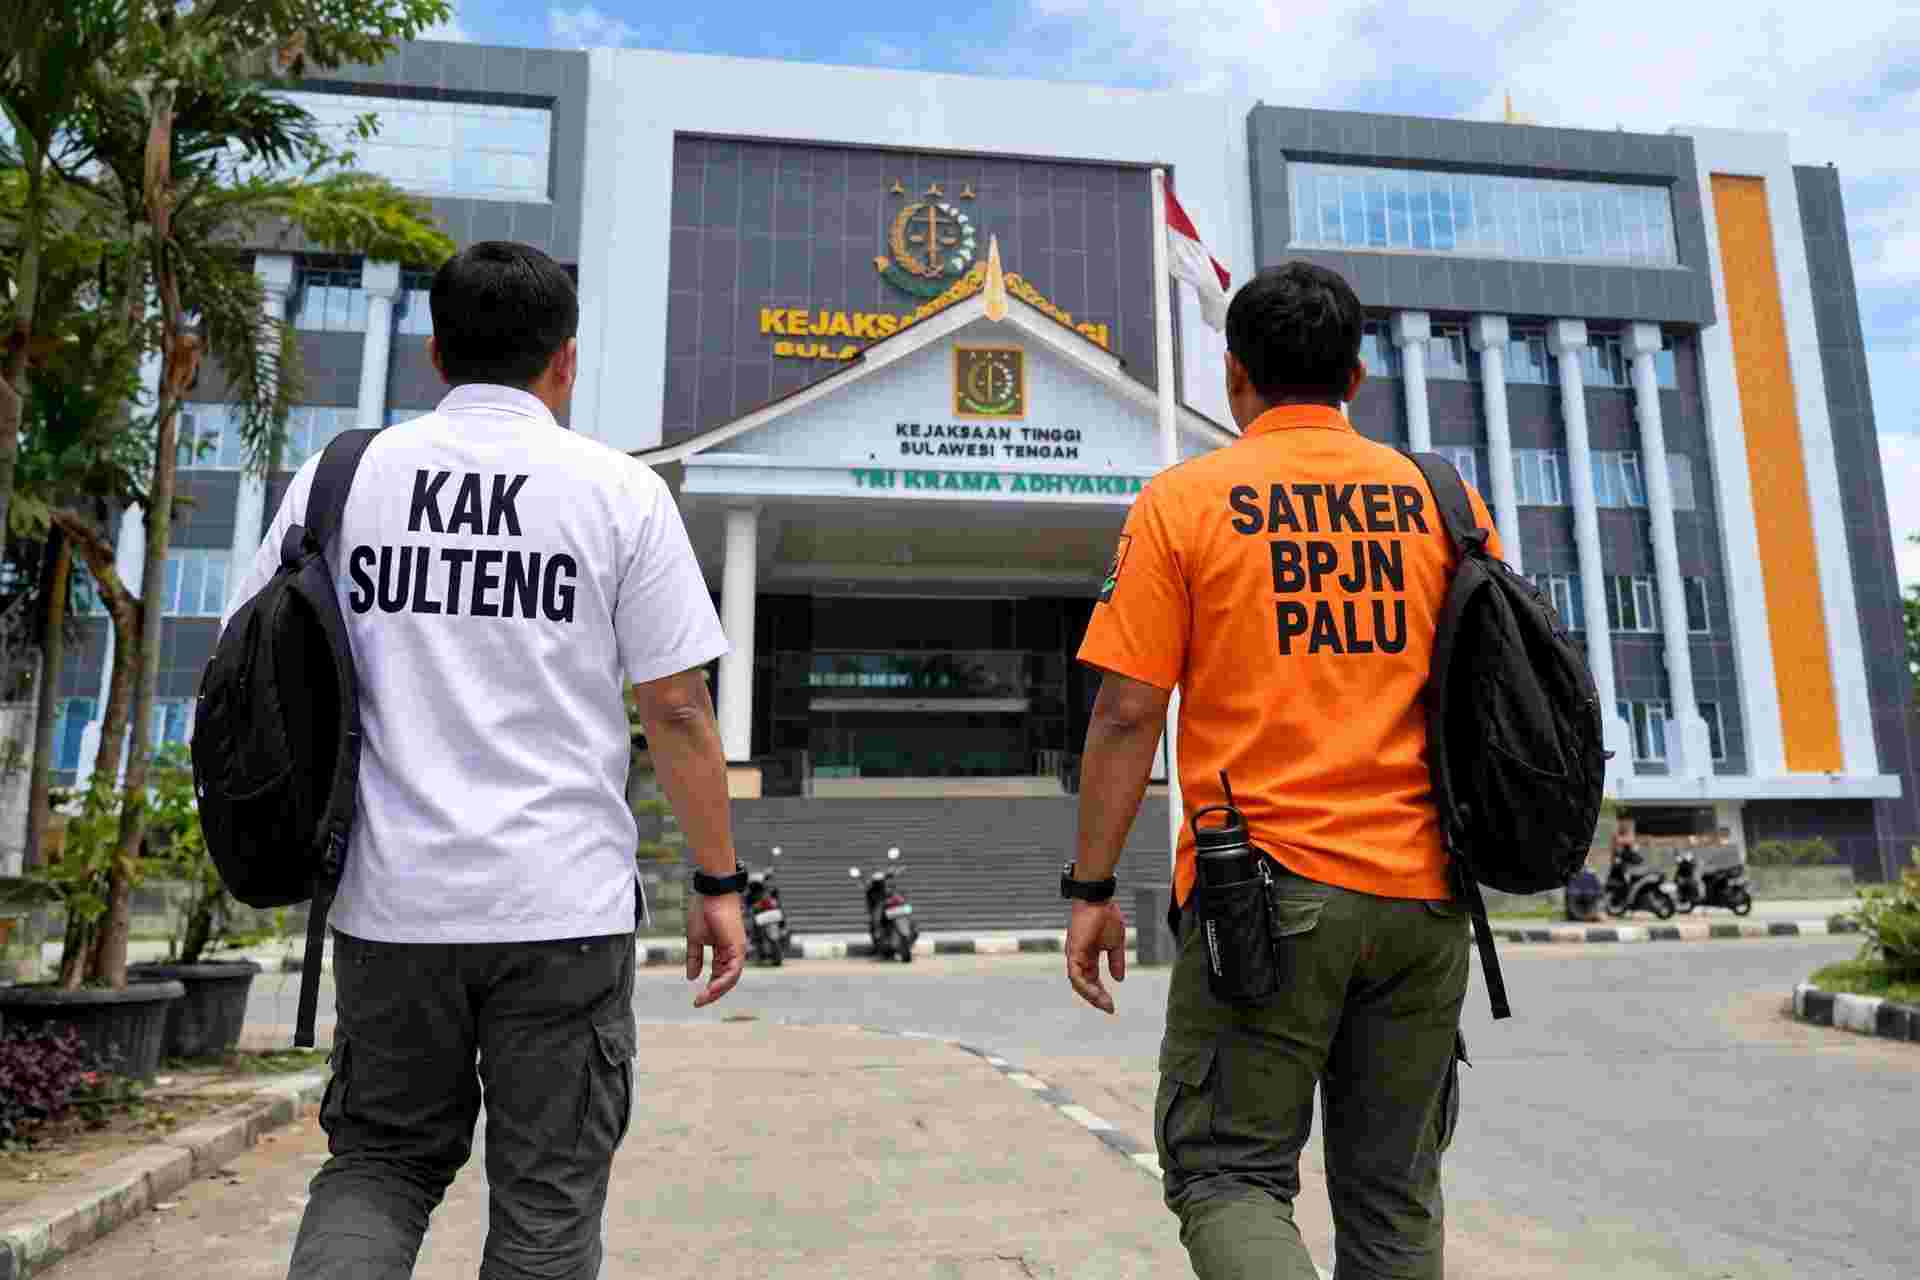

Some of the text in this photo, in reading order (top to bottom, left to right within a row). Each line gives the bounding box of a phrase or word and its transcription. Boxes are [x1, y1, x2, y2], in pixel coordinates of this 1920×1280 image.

[896, 423, 1081, 443] KEJAKSAAN TINGGI
[900, 441, 1078, 459] SULAWESI TENGAH
[407, 469, 529, 536] KAK
[850, 468, 1143, 495] TRI KRAMA ADHYAKSA
[1229, 483, 1430, 535] SATKER
[350, 545, 577, 623] SULTENG
[1270, 540, 1405, 593] BPJN
[1275, 600, 1407, 655] PALU
